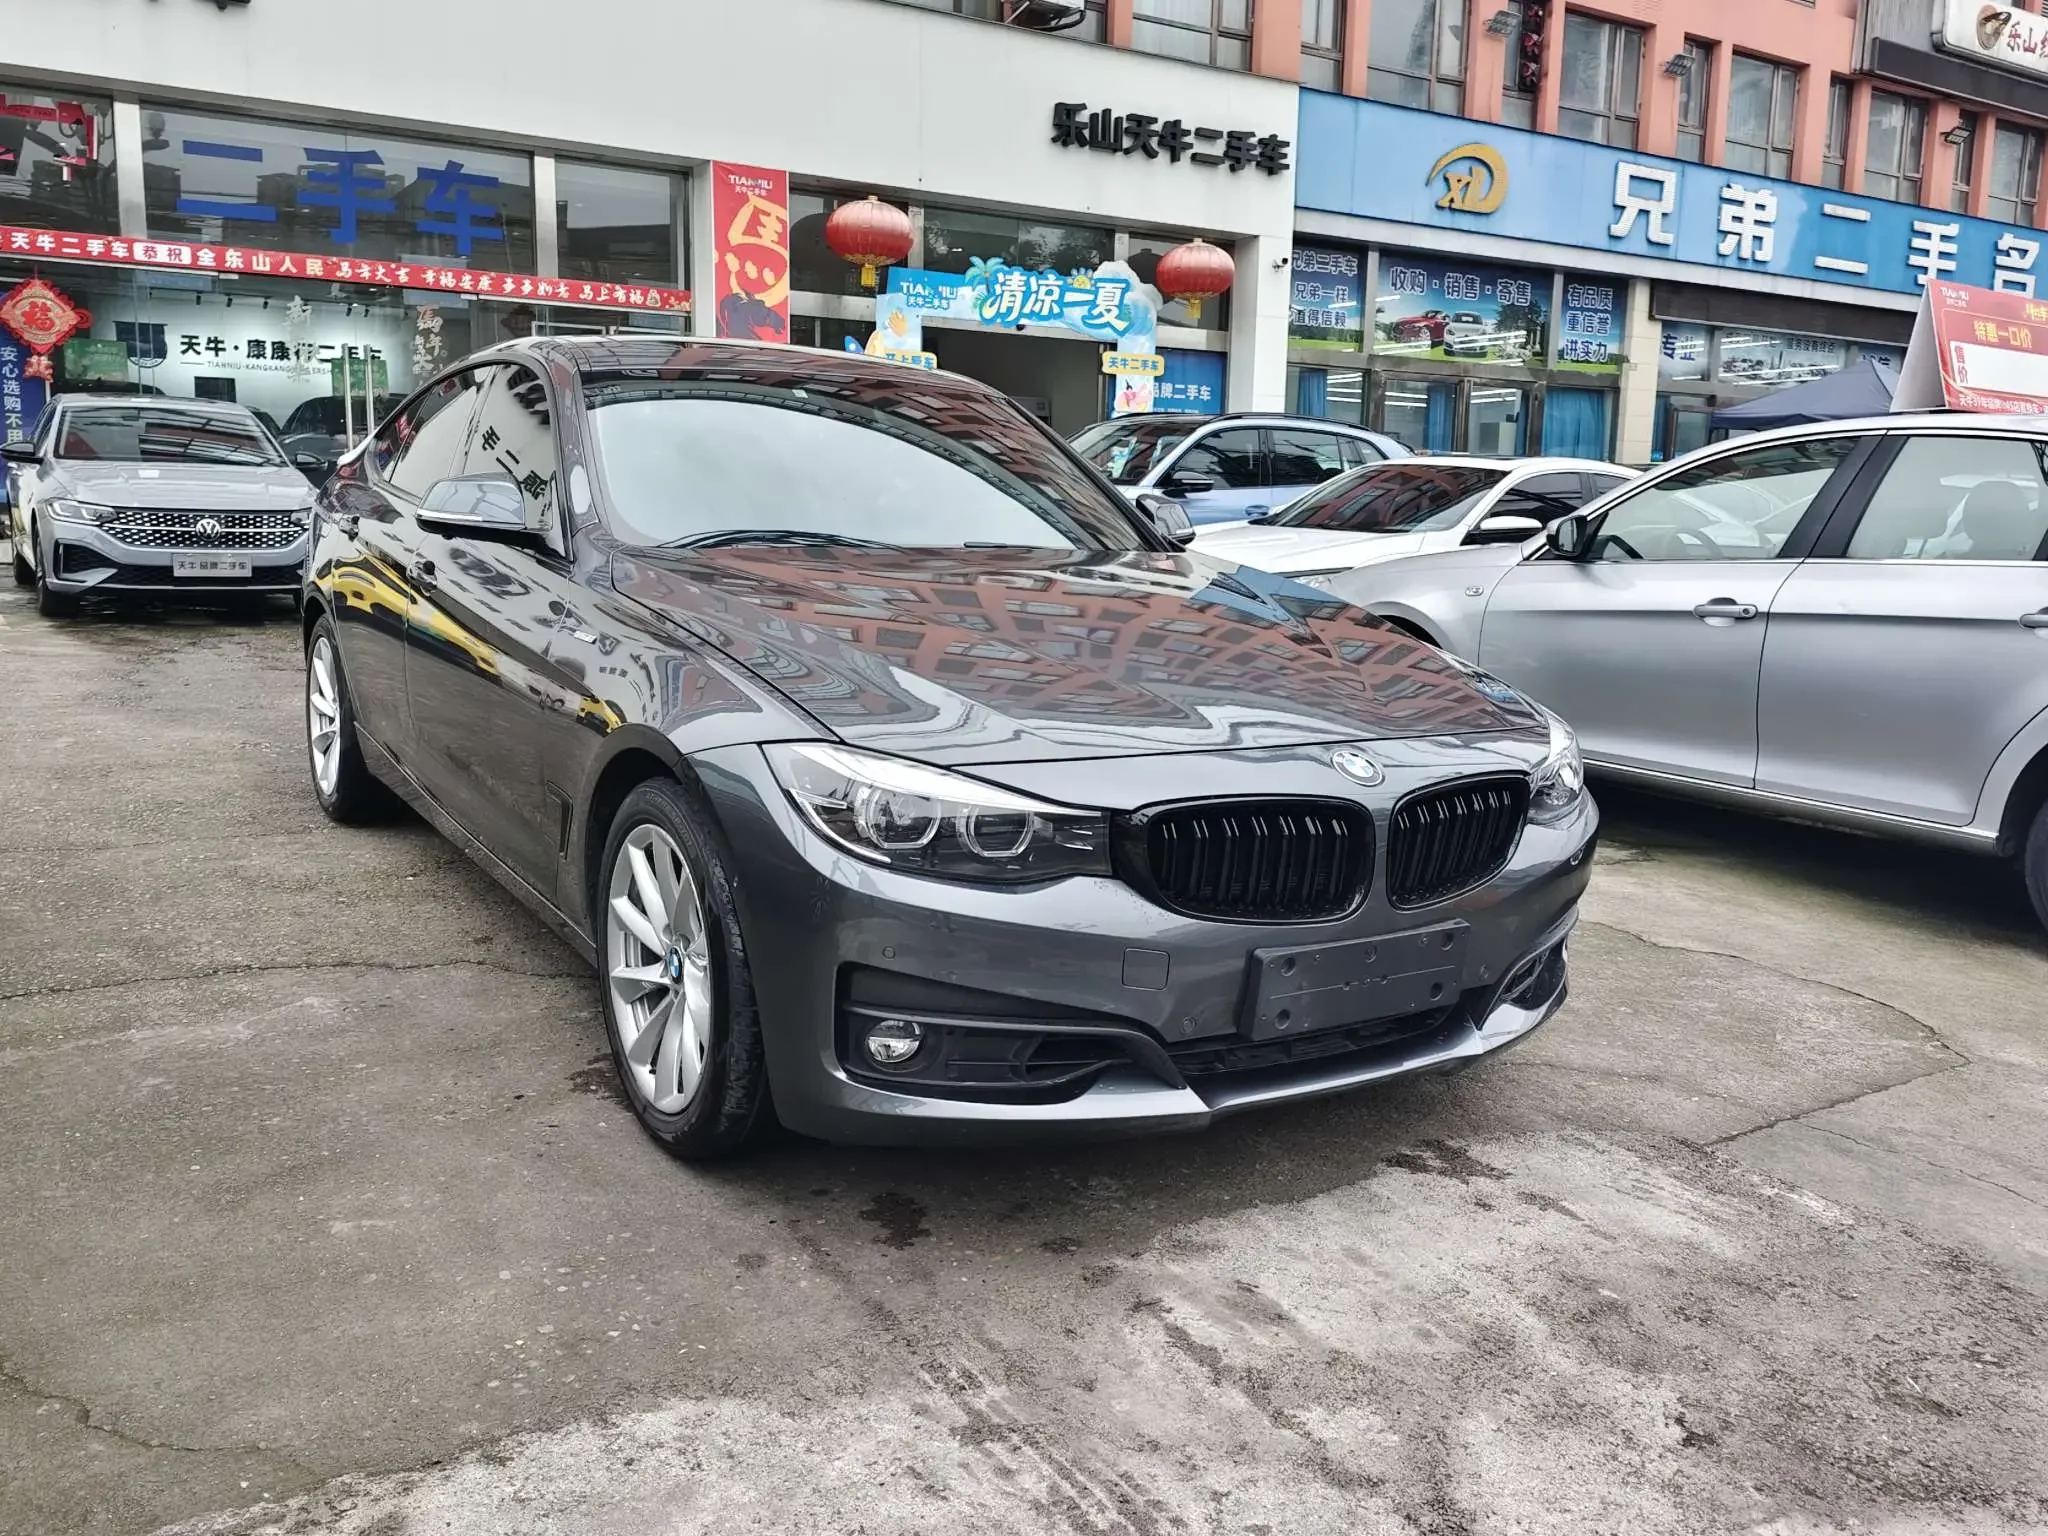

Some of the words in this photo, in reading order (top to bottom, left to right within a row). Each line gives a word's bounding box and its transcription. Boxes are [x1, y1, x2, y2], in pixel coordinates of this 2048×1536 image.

[1051, 102, 1290, 176] 乐山天牛二手车
[177, 140, 503, 257] 二手车
[11, 231, 130, 259] 天牛二手车
[142, 244, 183, 263] 恭祝
[907, 296, 950, 310] 天牛二手车
[982, 271, 1131, 332] 清凉一夏
[1294, 281, 1349, 304] 兄弟一样
[1568, 284, 1614, 311] 有品质
[1565, 311, 1611, 337] 重信誉
[1563, 337, 1609, 363] 讲实力
[1107, 356, 1160, 371] 天牛二手车
